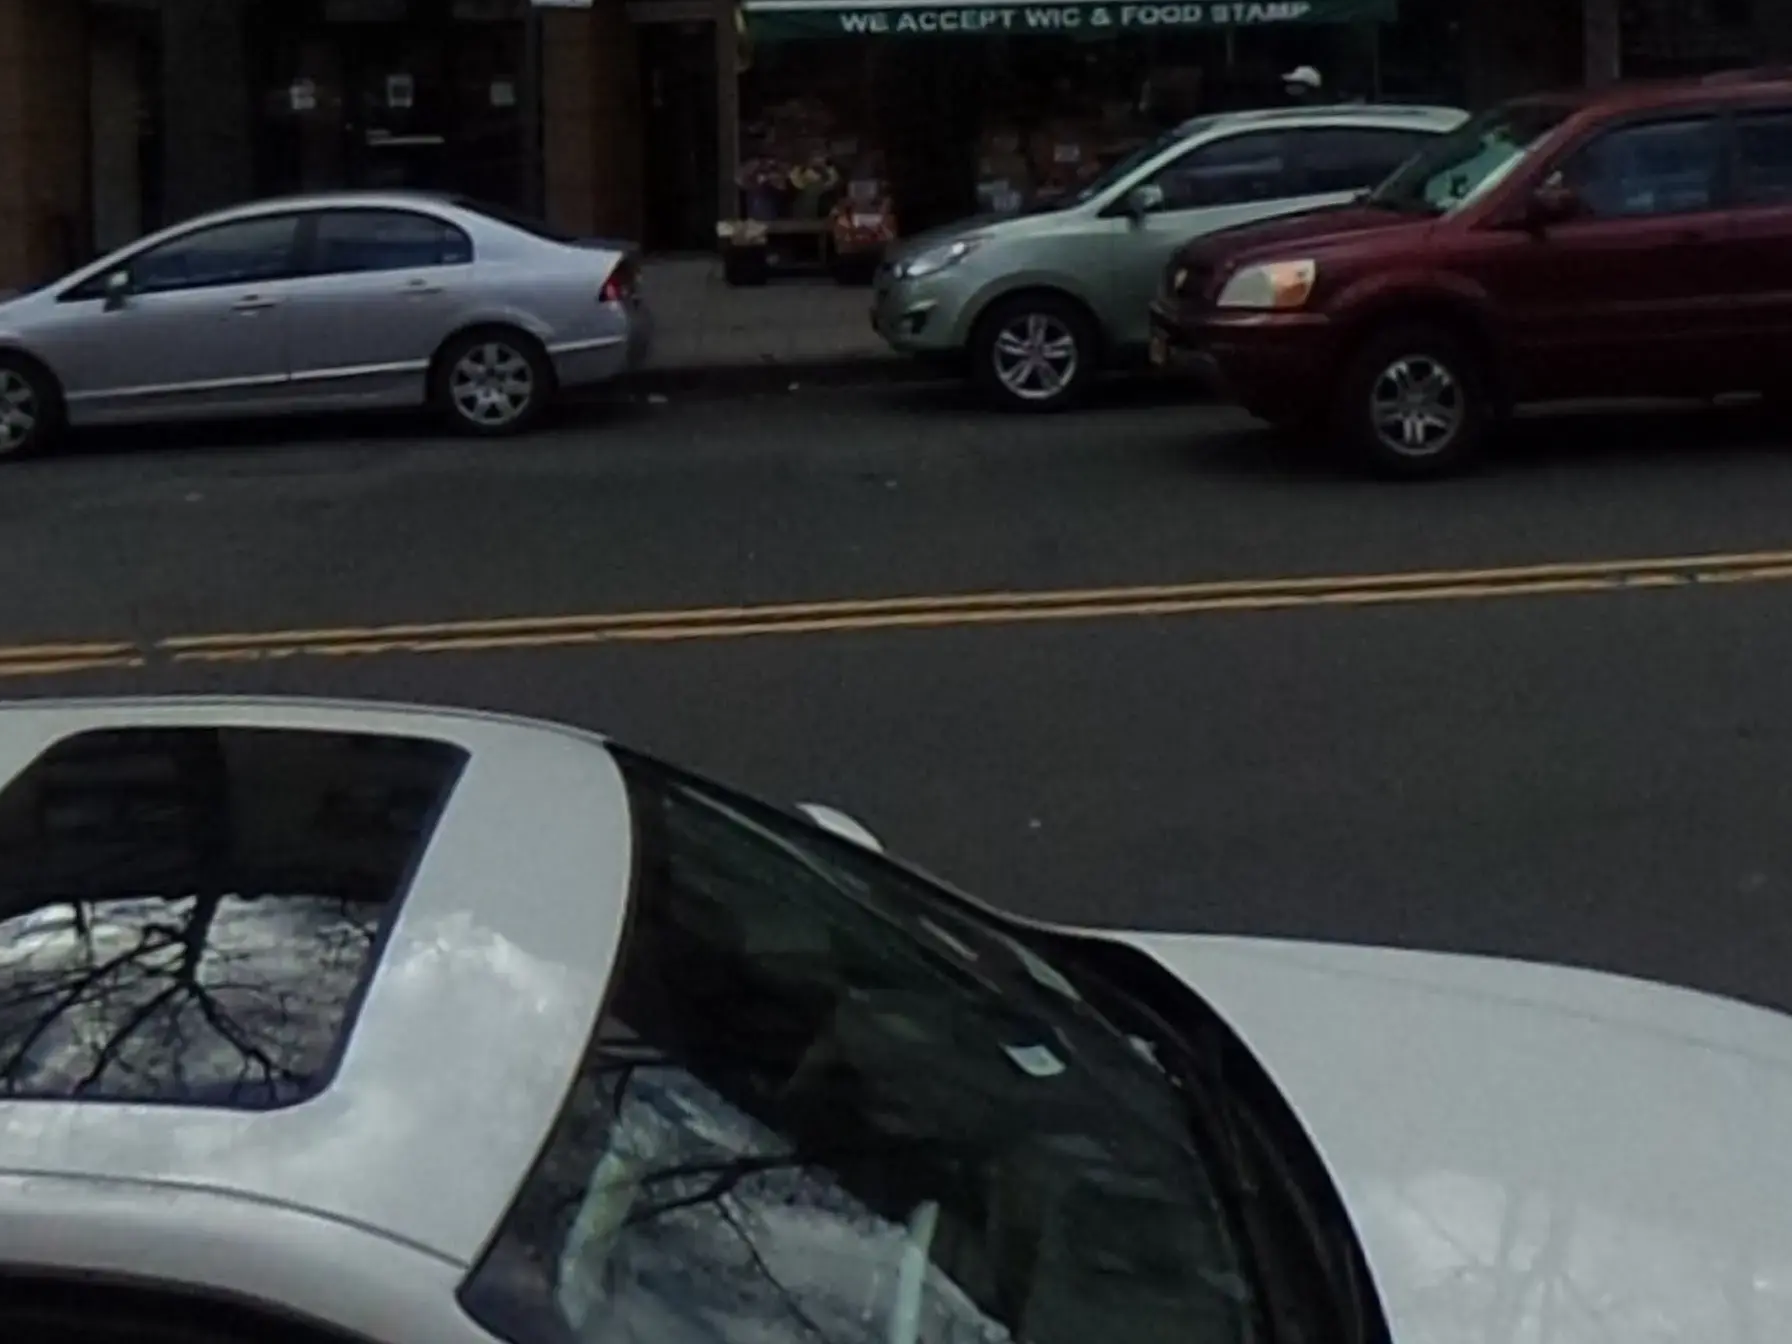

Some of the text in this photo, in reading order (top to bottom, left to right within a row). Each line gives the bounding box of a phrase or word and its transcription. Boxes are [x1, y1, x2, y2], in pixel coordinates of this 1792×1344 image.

[840, 1, 1311, 34] WE ACCEPT WIC & FOOD STAMP
